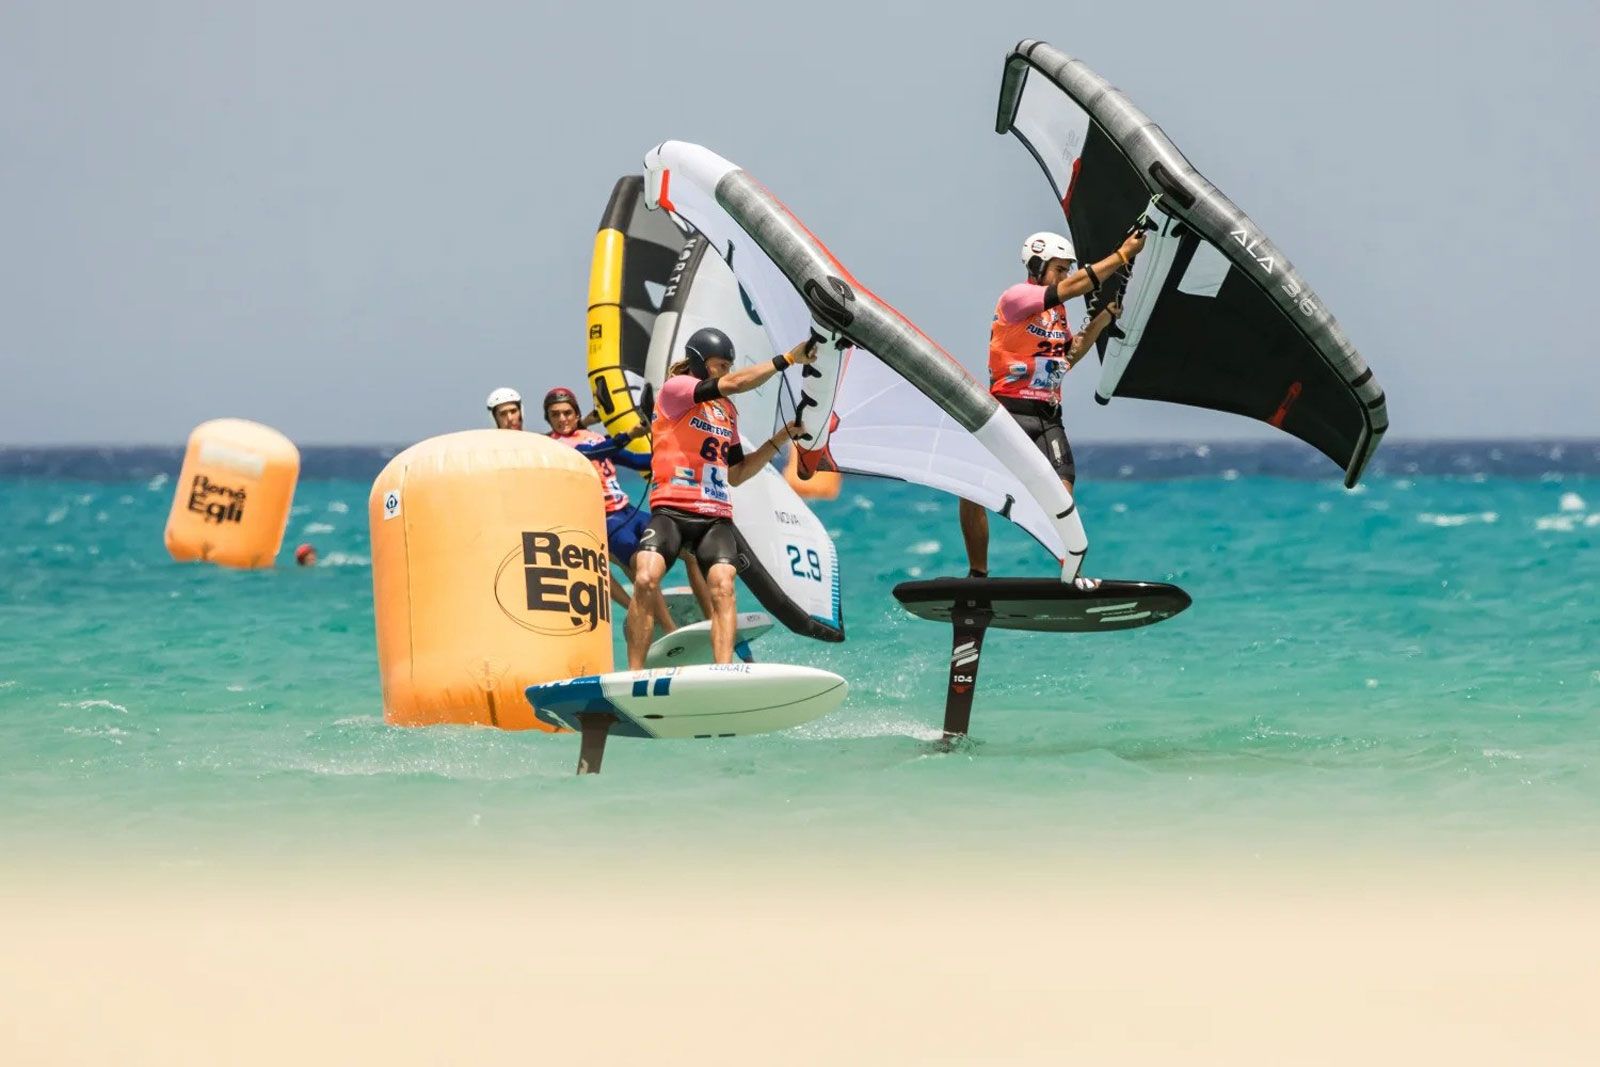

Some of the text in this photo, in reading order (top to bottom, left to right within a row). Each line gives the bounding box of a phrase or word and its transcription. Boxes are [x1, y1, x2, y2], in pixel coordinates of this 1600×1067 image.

[665, 238, 697, 297] NORTH
[1230, 230, 1318, 317] ALA 3.6
[188, 492, 244, 524] Egli
[774, 510, 800, 525] NOVA
[521, 531, 608, 577] René
[786, 544, 822, 582] 2.9
[524, 566, 610, 632] Egli
[953, 675, 973, 683] 104
